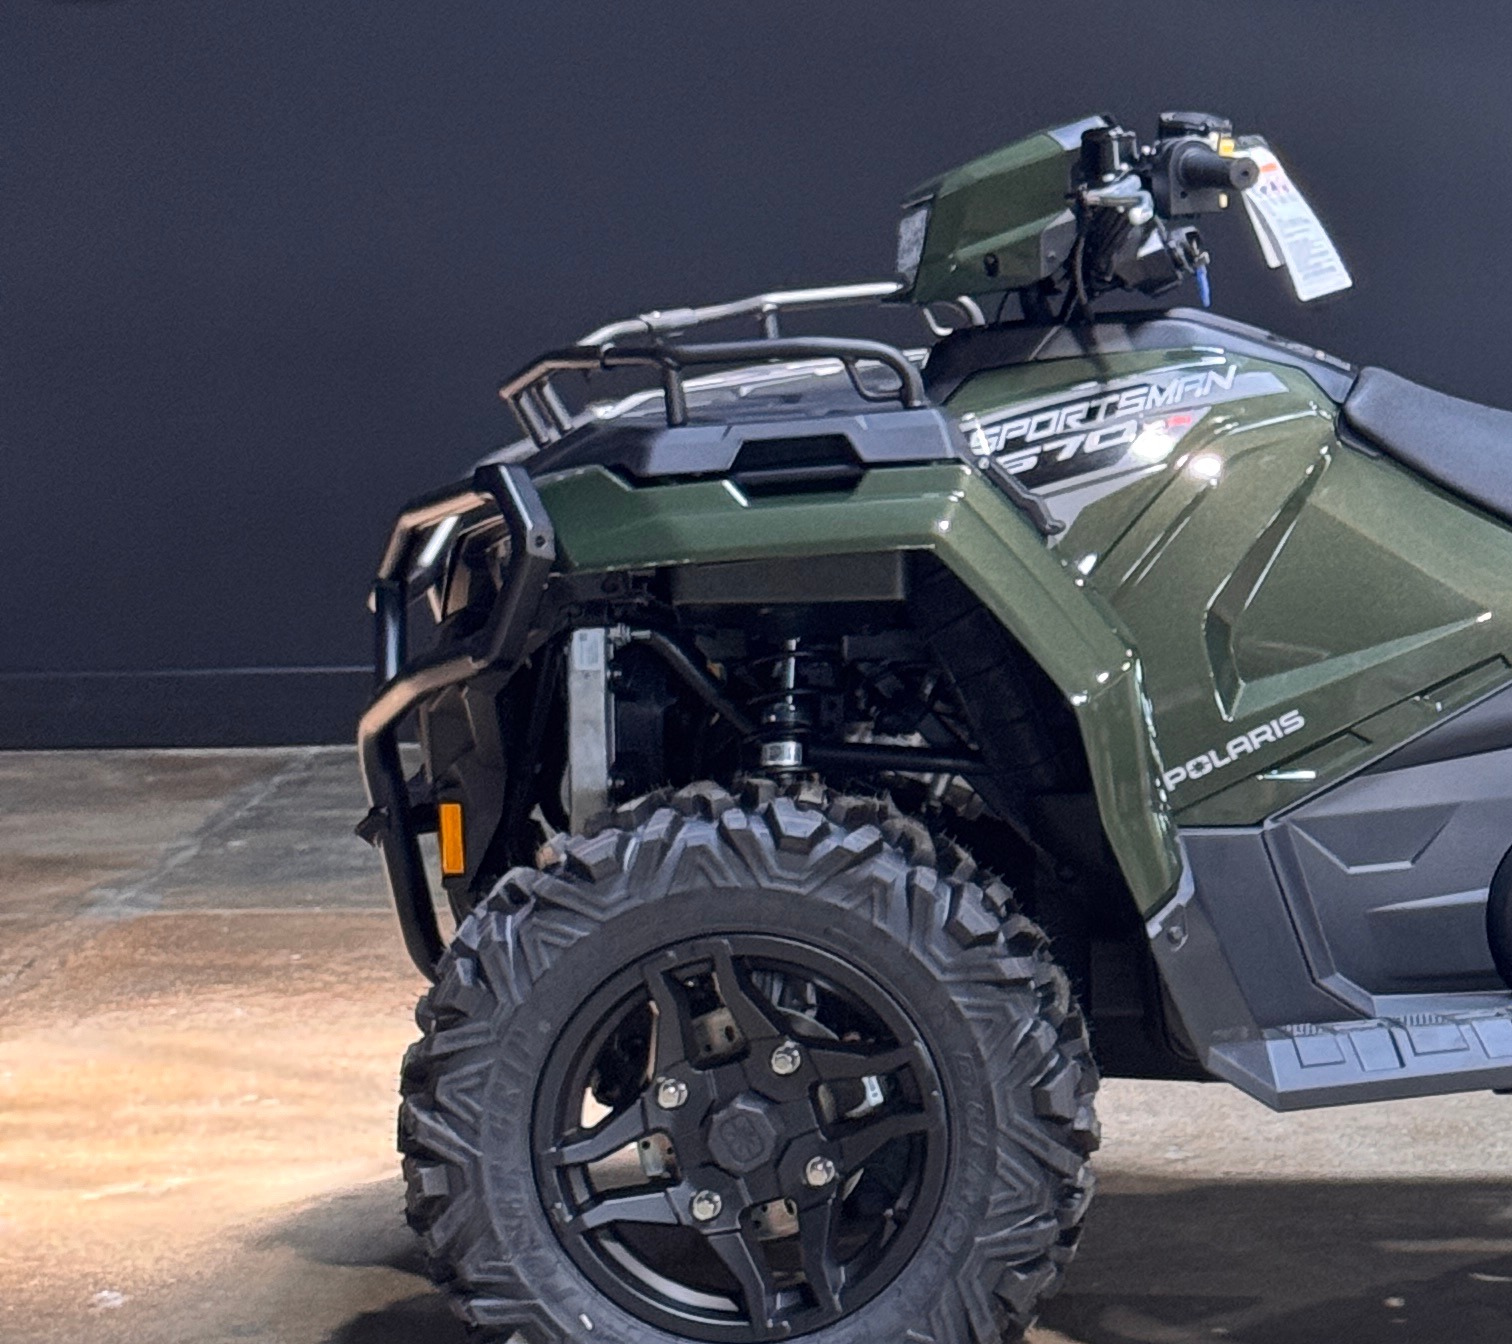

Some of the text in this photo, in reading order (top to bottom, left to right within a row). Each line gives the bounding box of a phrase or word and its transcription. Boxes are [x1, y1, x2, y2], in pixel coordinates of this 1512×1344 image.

[969, 364, 1237, 455] SPORTSMAN
[996, 419, 1137, 475] 570
[1163, 709, 1305, 792] POLARIS
